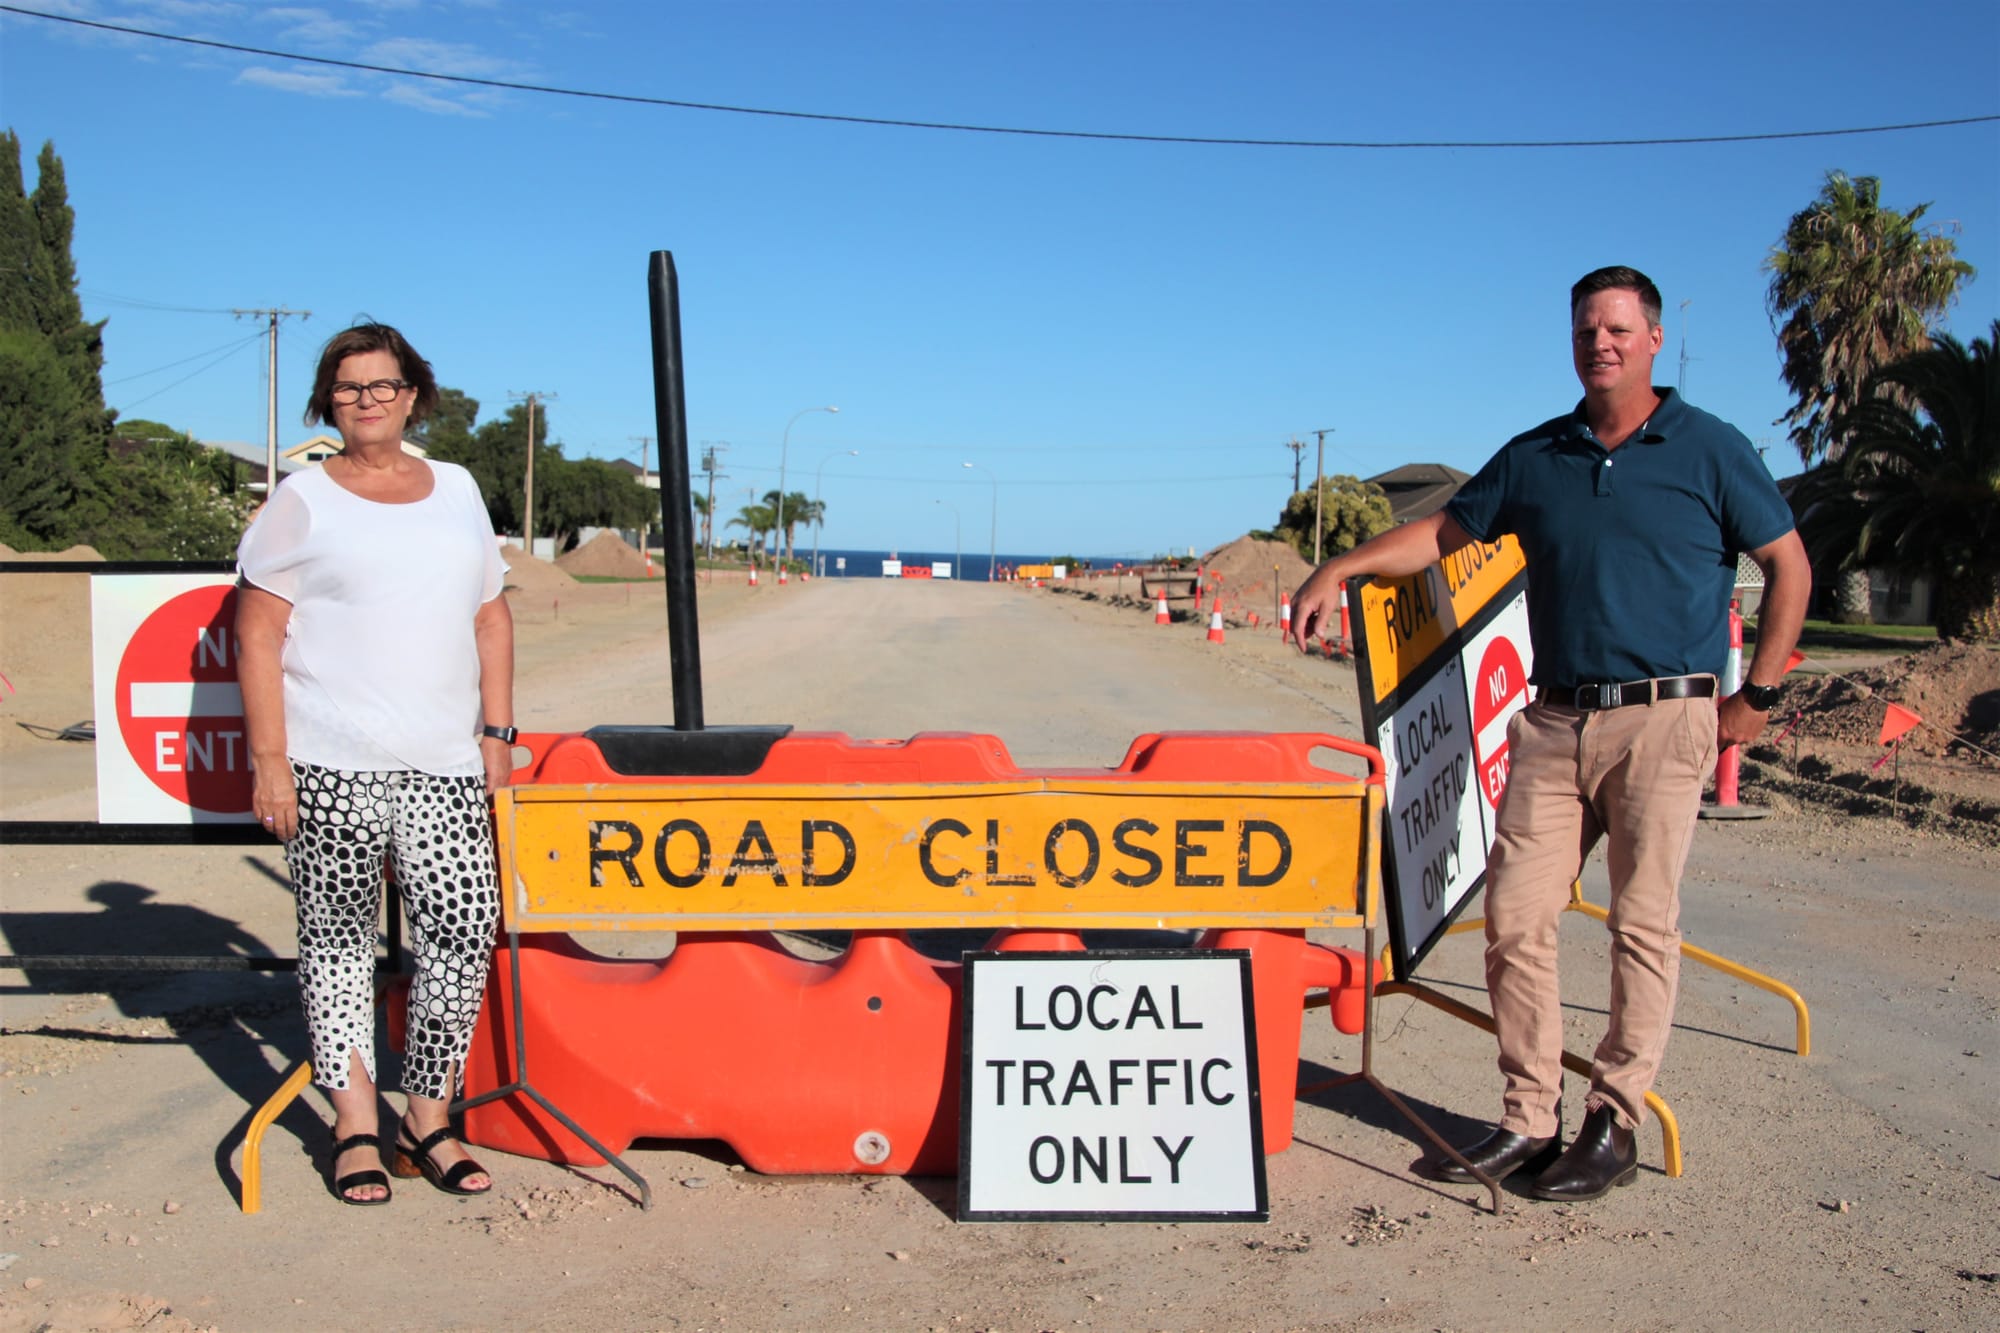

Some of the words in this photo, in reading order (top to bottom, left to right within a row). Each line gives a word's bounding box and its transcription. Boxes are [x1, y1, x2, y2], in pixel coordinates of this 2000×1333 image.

[1383, 566, 1438, 655] ROAD
[198, 627, 241, 668] N
[1488, 664, 1507, 708] NO
[156, 731, 254, 772] ENT
[1397, 693, 1453, 779] LOCAL
[1401, 752, 1467, 854] TRAFFIC
[589, 818, 857, 888] ROAD
[919, 818, 1292, 888] CLOSED
[1422, 829, 1461, 911] ONLY
[1015, 984, 1204, 1031] LOCAL
[985, 1058, 1235, 1106] TRAFFIC
[1029, 1135, 1195, 1184] ONLY
